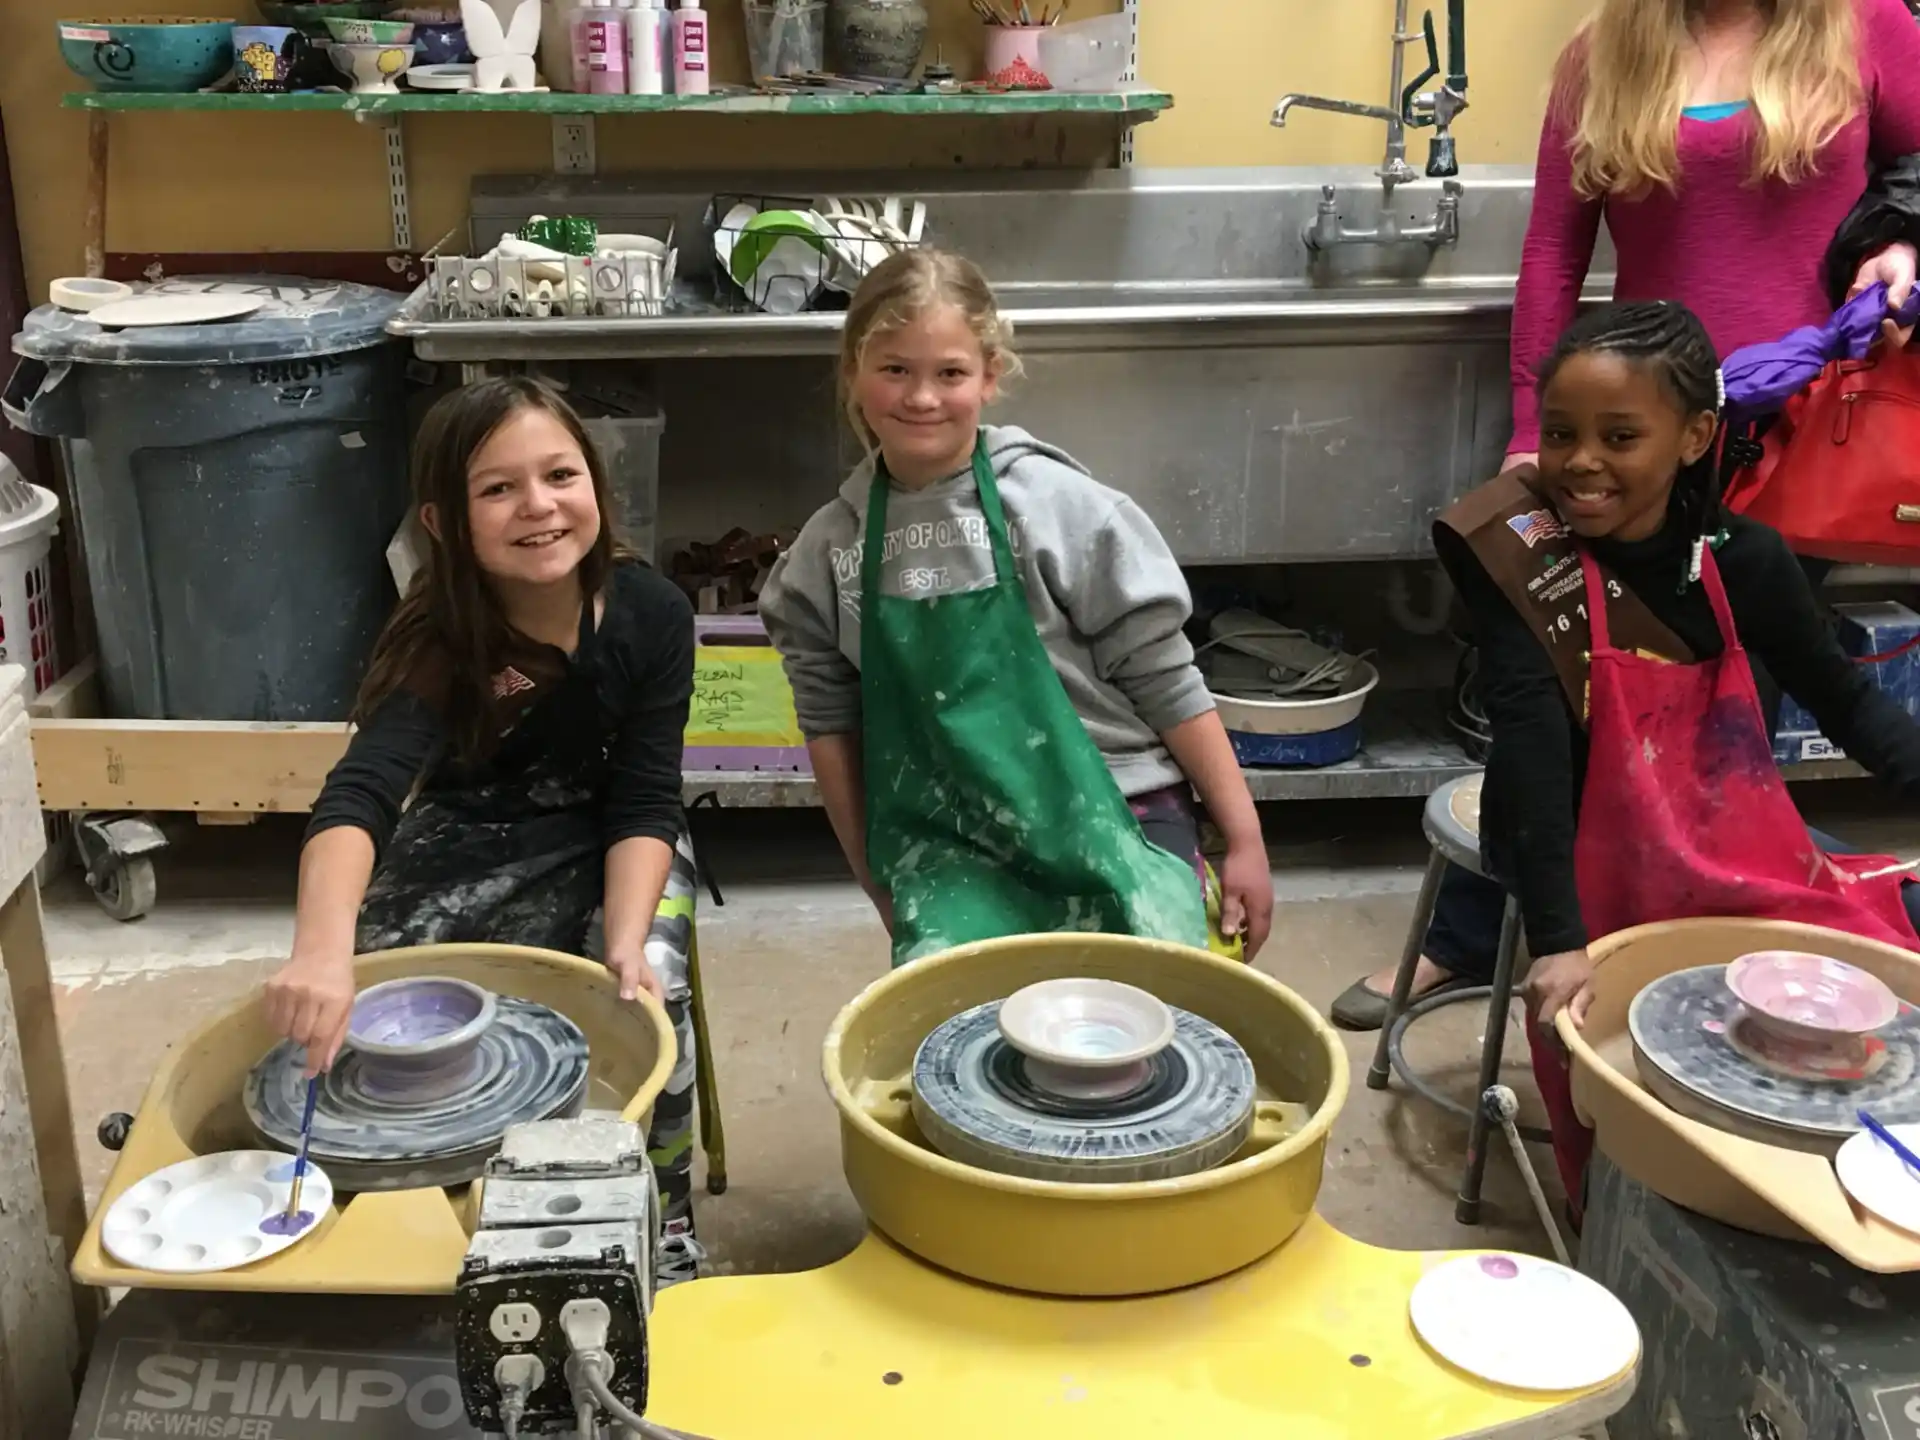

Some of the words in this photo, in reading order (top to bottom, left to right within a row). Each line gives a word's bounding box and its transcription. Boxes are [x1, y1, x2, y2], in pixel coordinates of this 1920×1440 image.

[905, 521, 933, 549] OF
[1543, 556, 1571, 580] SCOUTS
[132, 1353, 464, 1430] SHIMPO
